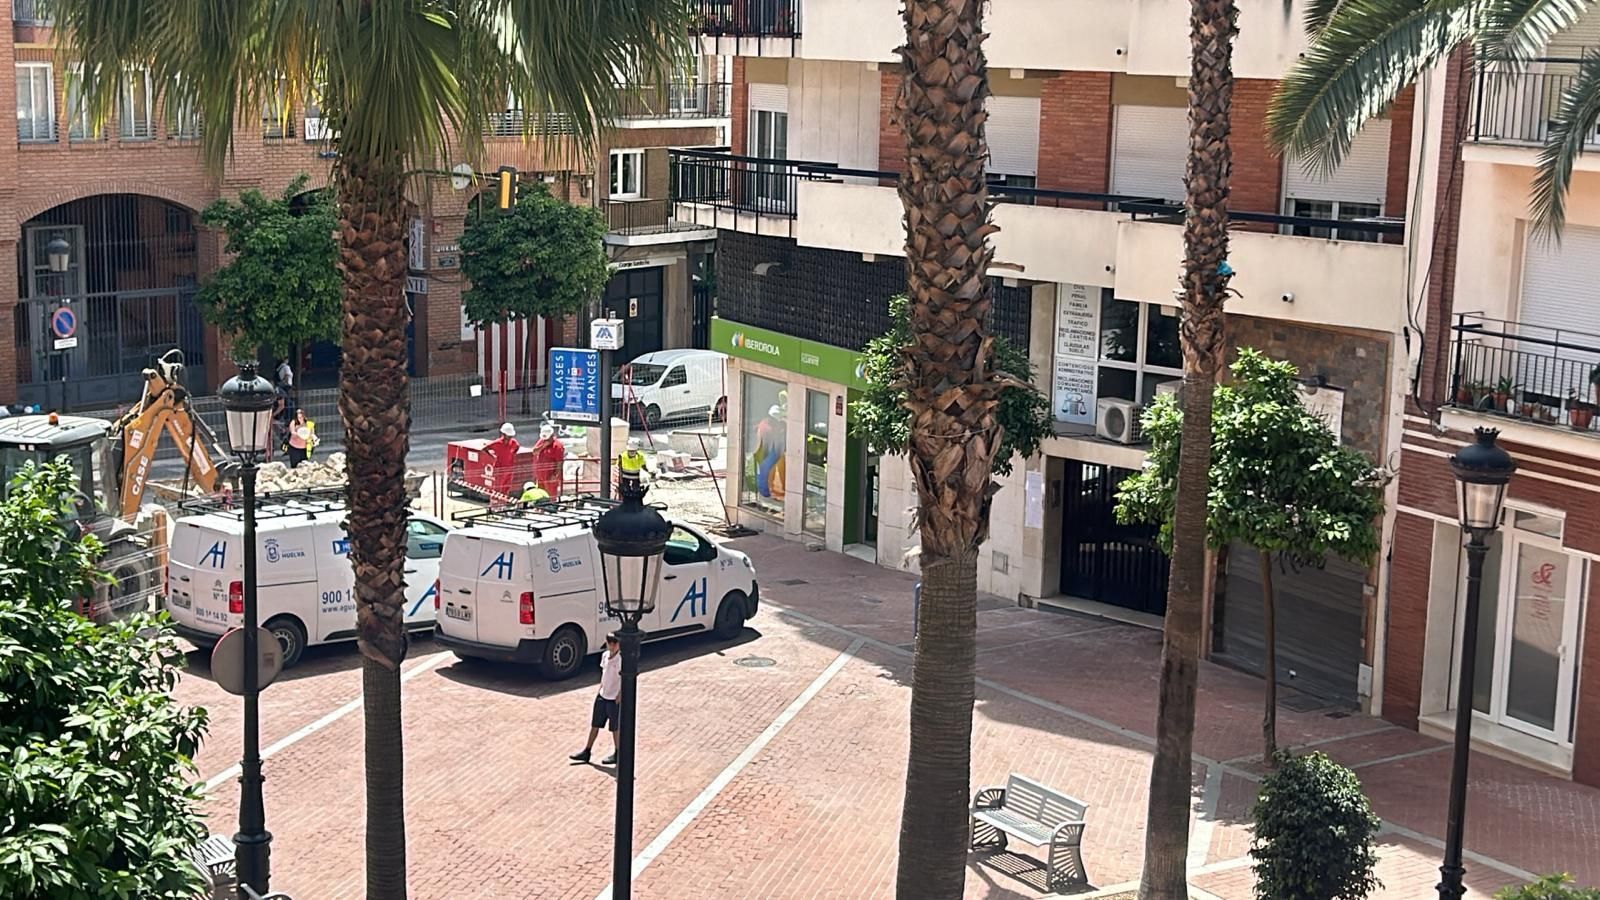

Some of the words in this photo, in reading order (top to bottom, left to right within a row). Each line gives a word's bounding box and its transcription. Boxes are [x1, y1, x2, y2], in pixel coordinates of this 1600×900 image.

[745, 338, 780, 356] IBERDROLA
[555, 355, 564, 399] CLASES
[586, 353, 596, 406] FRANCÉS
[132, 455, 149, 495] CASE
[562, 559, 582, 568] HUELVA
[322, 590, 342, 604] 900
